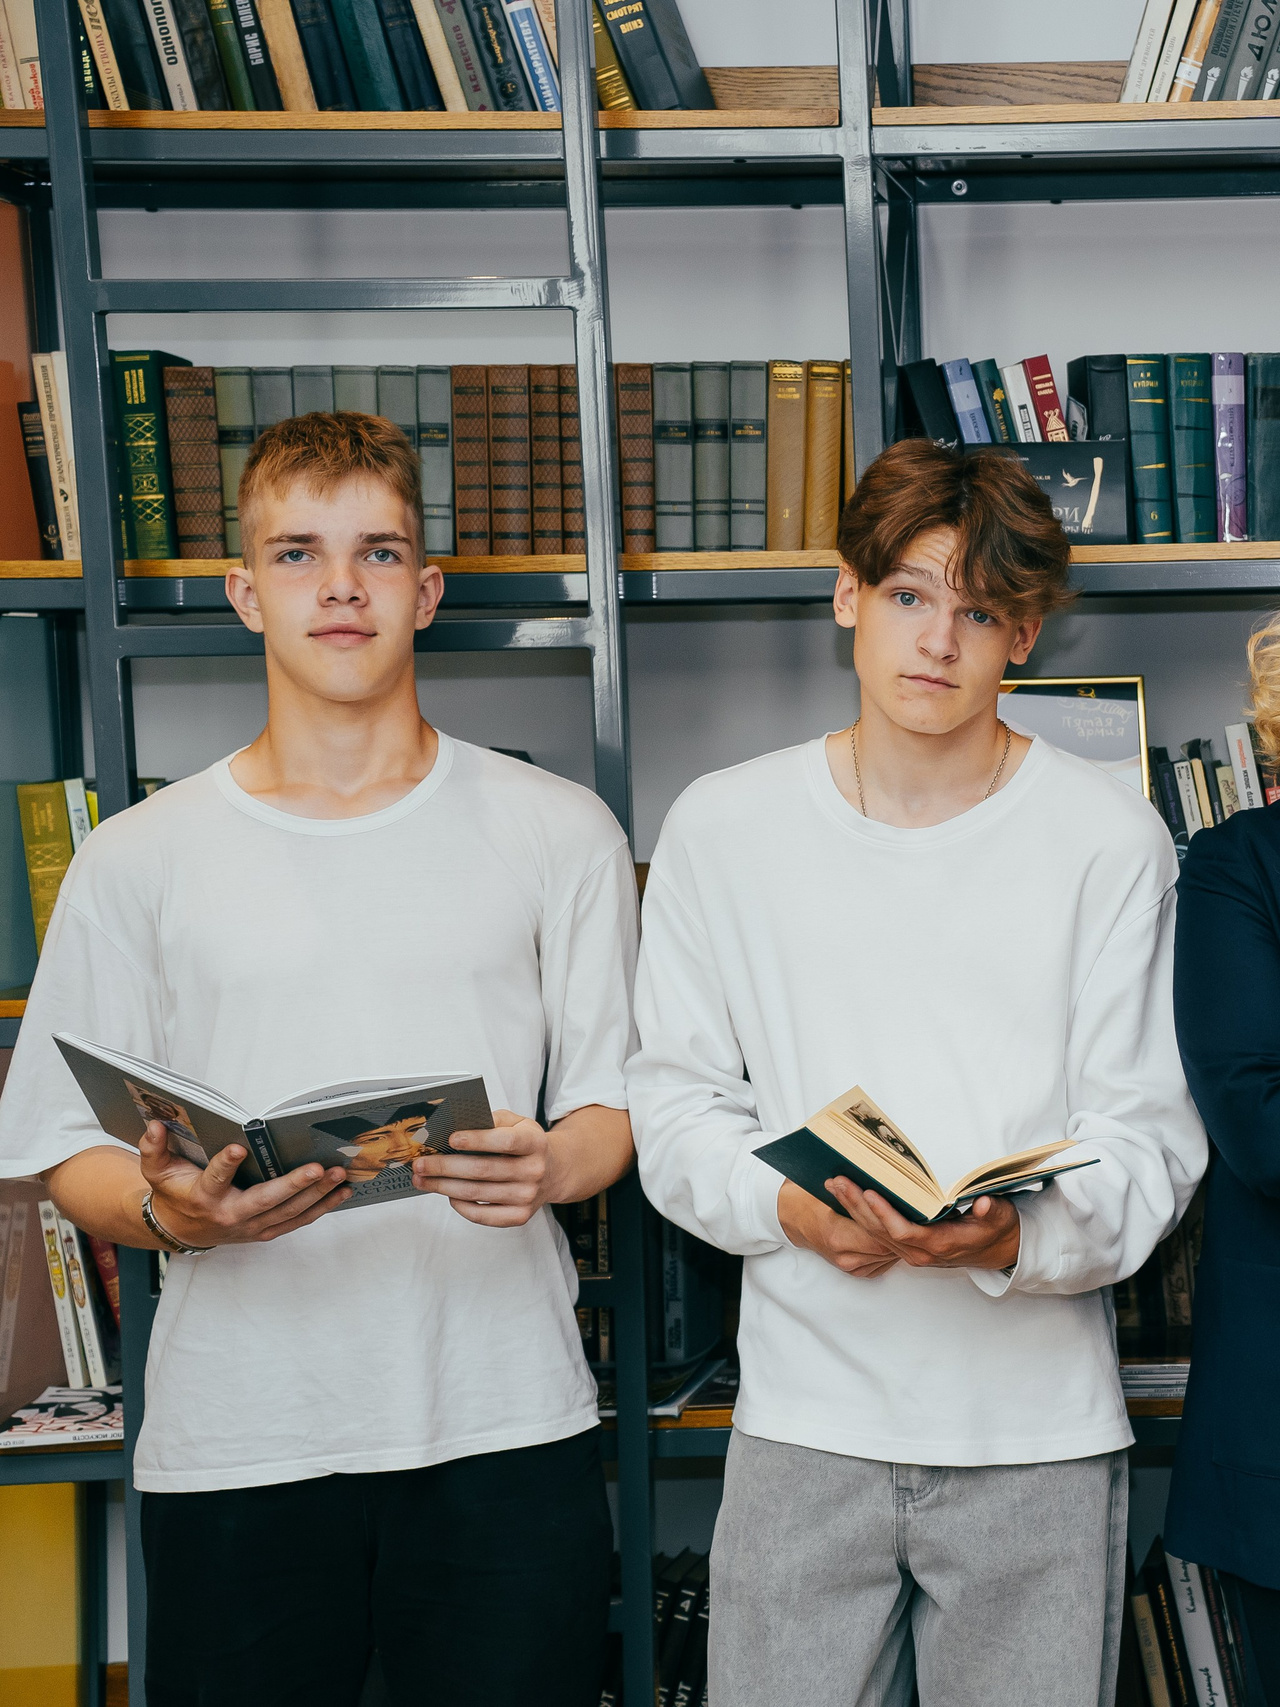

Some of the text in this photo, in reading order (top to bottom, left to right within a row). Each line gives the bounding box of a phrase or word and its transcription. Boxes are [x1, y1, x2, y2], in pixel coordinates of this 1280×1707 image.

[606, 1, 643, 21] СМОТРЯТ
[619, 18, 644, 34] ВНИЗ
[93, 32, 109, 63] ТВОИХ
[243, 32, 264, 66] БОРИС
[518, 18, 558, 112] КНИГА БРАТСТВА
[105, 74, 122, 108] СКАЗЫ
[39, 364, 68, 483] ДРАМАТИЧЕСКИЕ ПРОИЗВЕДЕНИЯ
[1244, 789, 1256, 807] еатр
[71, 1432, 108, 1442] ИСКУССТВ
